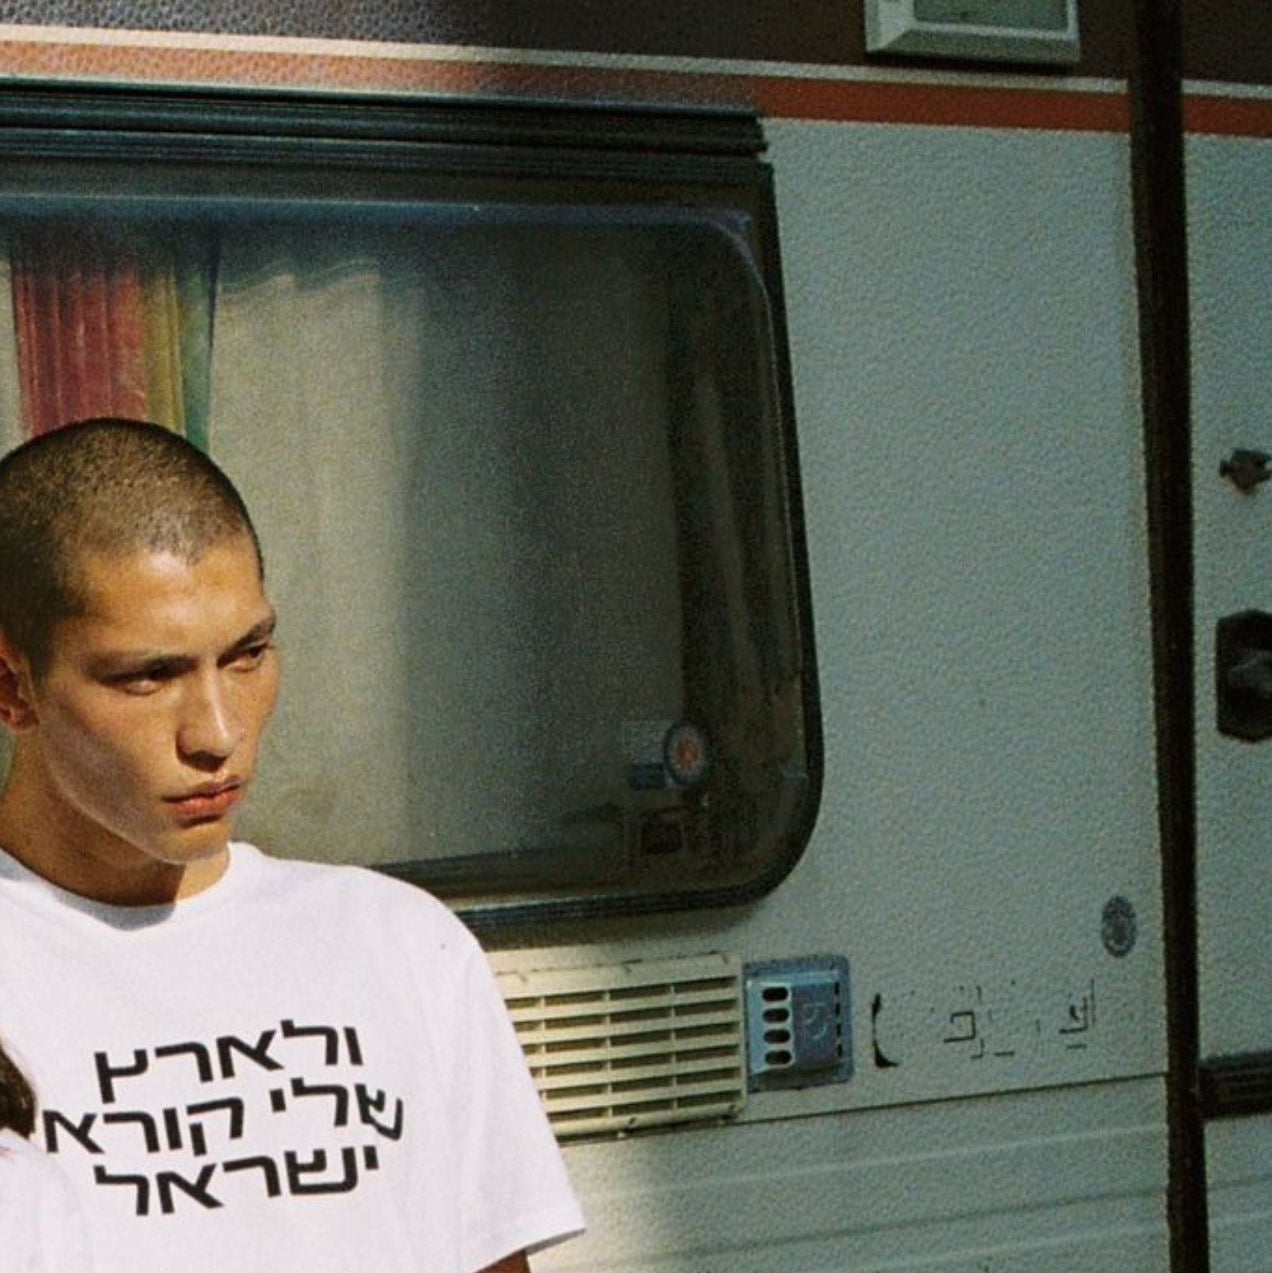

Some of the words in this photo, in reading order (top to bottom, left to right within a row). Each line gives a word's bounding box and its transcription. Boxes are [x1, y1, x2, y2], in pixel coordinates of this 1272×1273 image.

[94, 1019, 363, 1104] ולארץ
[41, 1097, 246, 1157] קורא
[269, 1077, 404, 1141] שלי
[93, 1145, 380, 1216] ישראל
